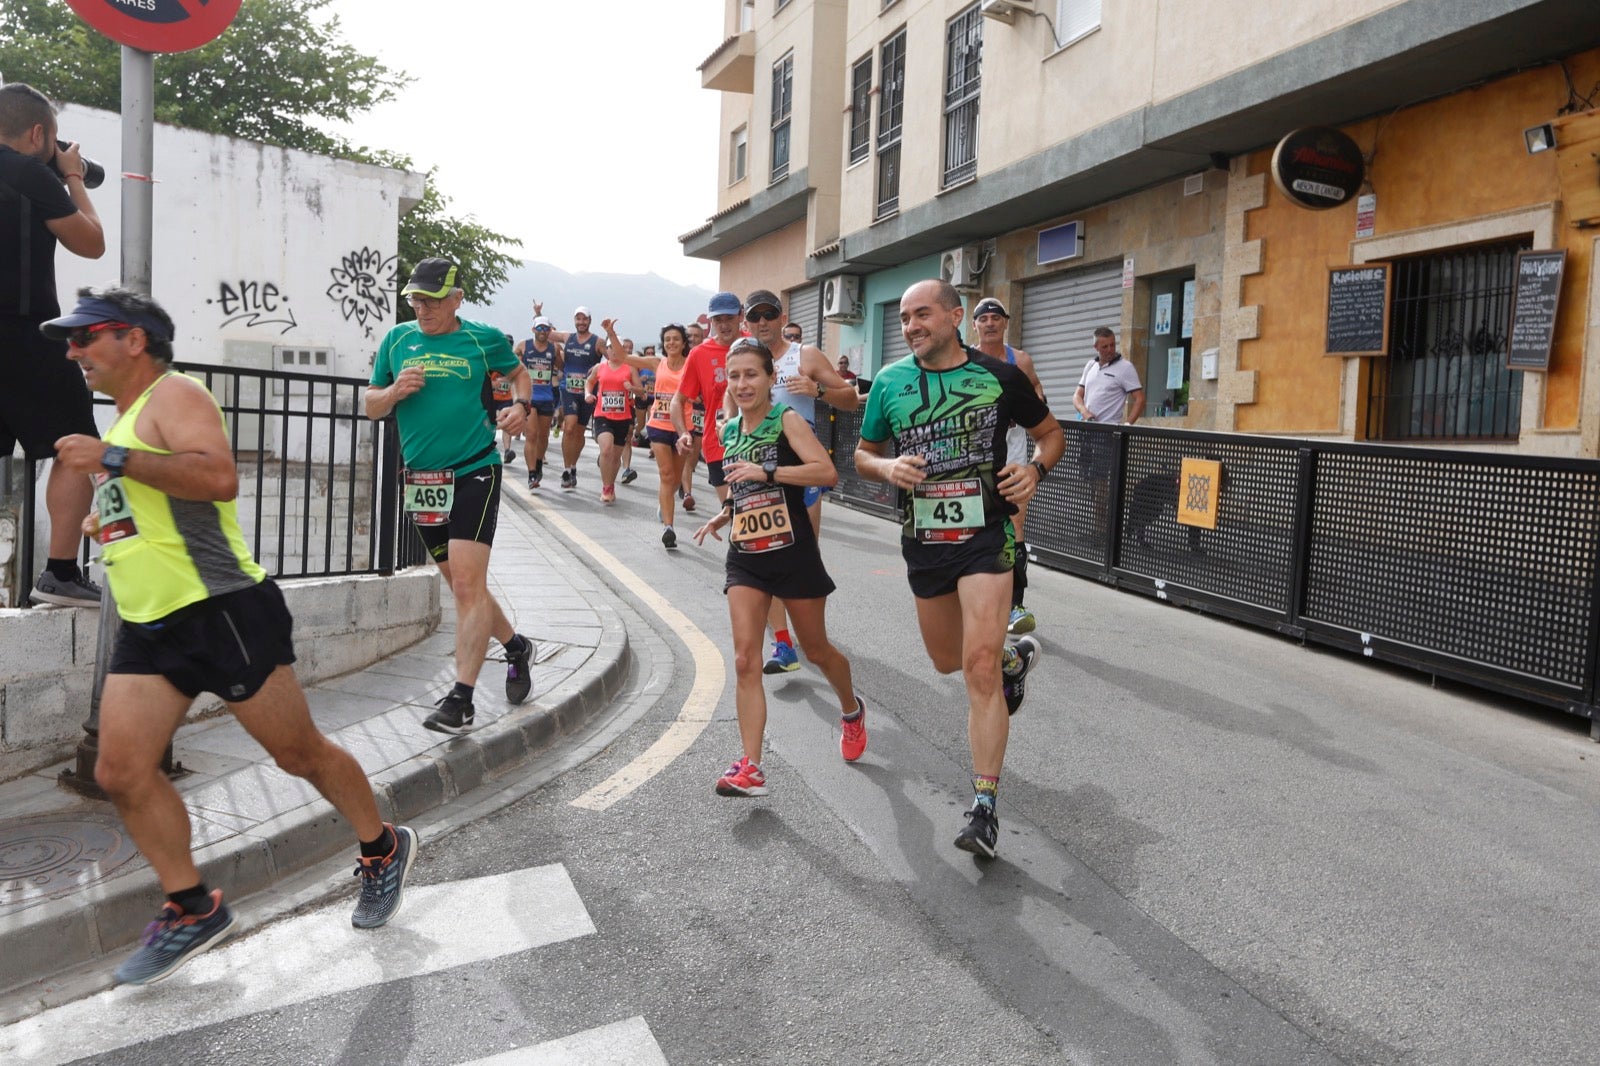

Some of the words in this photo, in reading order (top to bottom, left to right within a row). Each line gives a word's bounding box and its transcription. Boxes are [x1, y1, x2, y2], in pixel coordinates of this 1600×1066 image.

[537, 371, 543, 379] 6
[571, 379, 585, 388] 123
[604, 398, 624, 406] 3056
[930, 434, 968, 450] MENTE
[415, 488, 448, 508] 469
[934, 502, 964, 523] 43
[740, 509, 786, 535] 2006
